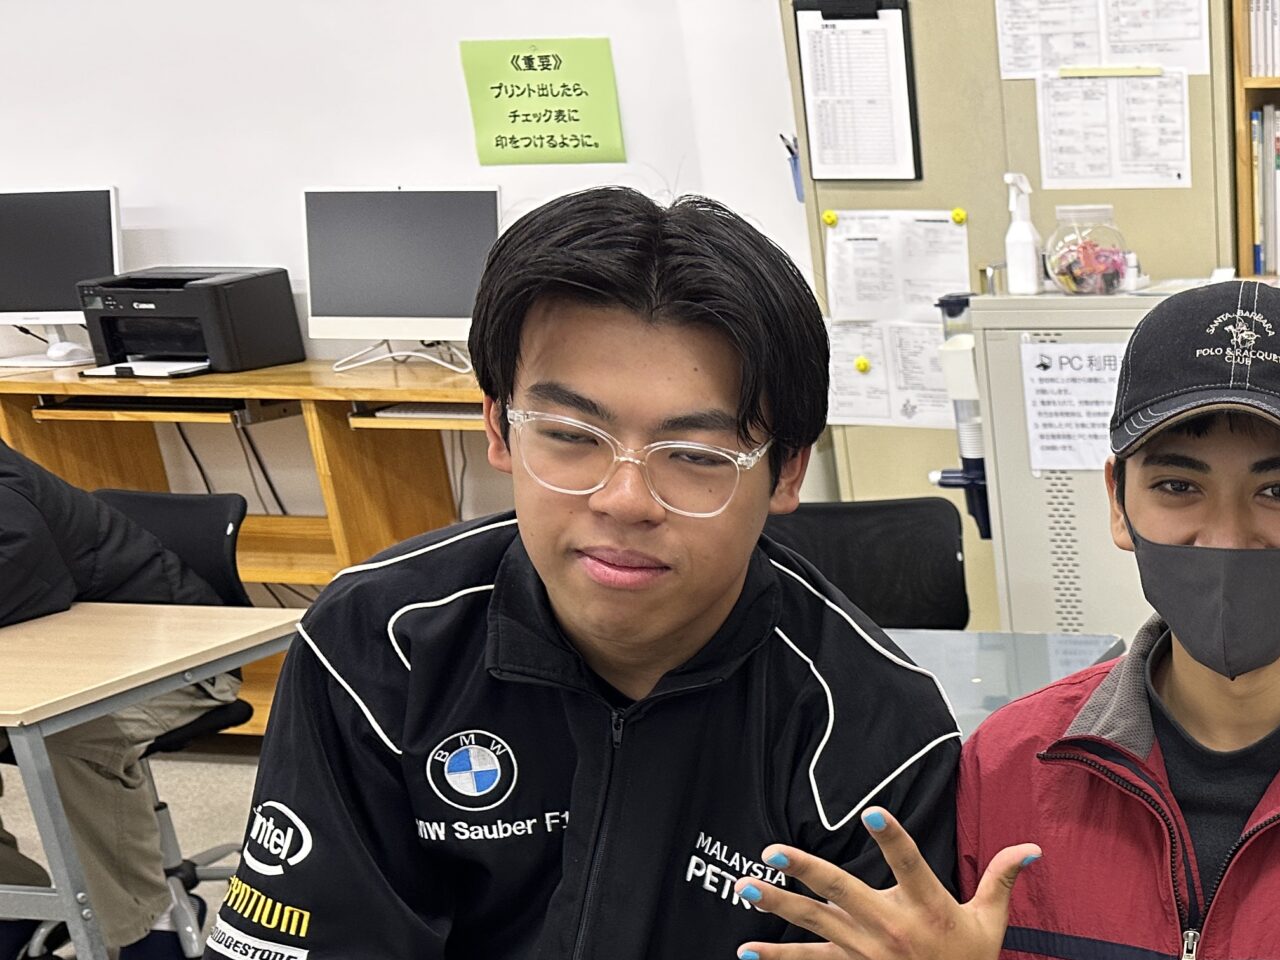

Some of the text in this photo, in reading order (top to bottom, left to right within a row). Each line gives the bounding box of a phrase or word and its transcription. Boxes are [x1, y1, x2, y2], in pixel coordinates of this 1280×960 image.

[510, 54, 562, 71] 《重要》
[490, 82, 589, 98] プリント出したら、
[508, 108, 580, 123] チェック表に
[495, 134, 600, 149] 印をつけるように。
[1237, 309, 1275, 337] BARBARA
[1196, 347, 1223, 358] POLO
[1225, 355, 1251, 366] CLUB
[434, 733, 507, 763] BMW
[453, 819, 537, 840] Sauber
[545, 811, 569, 832] F1
[695, 832, 787, 886] MALAYSIA
